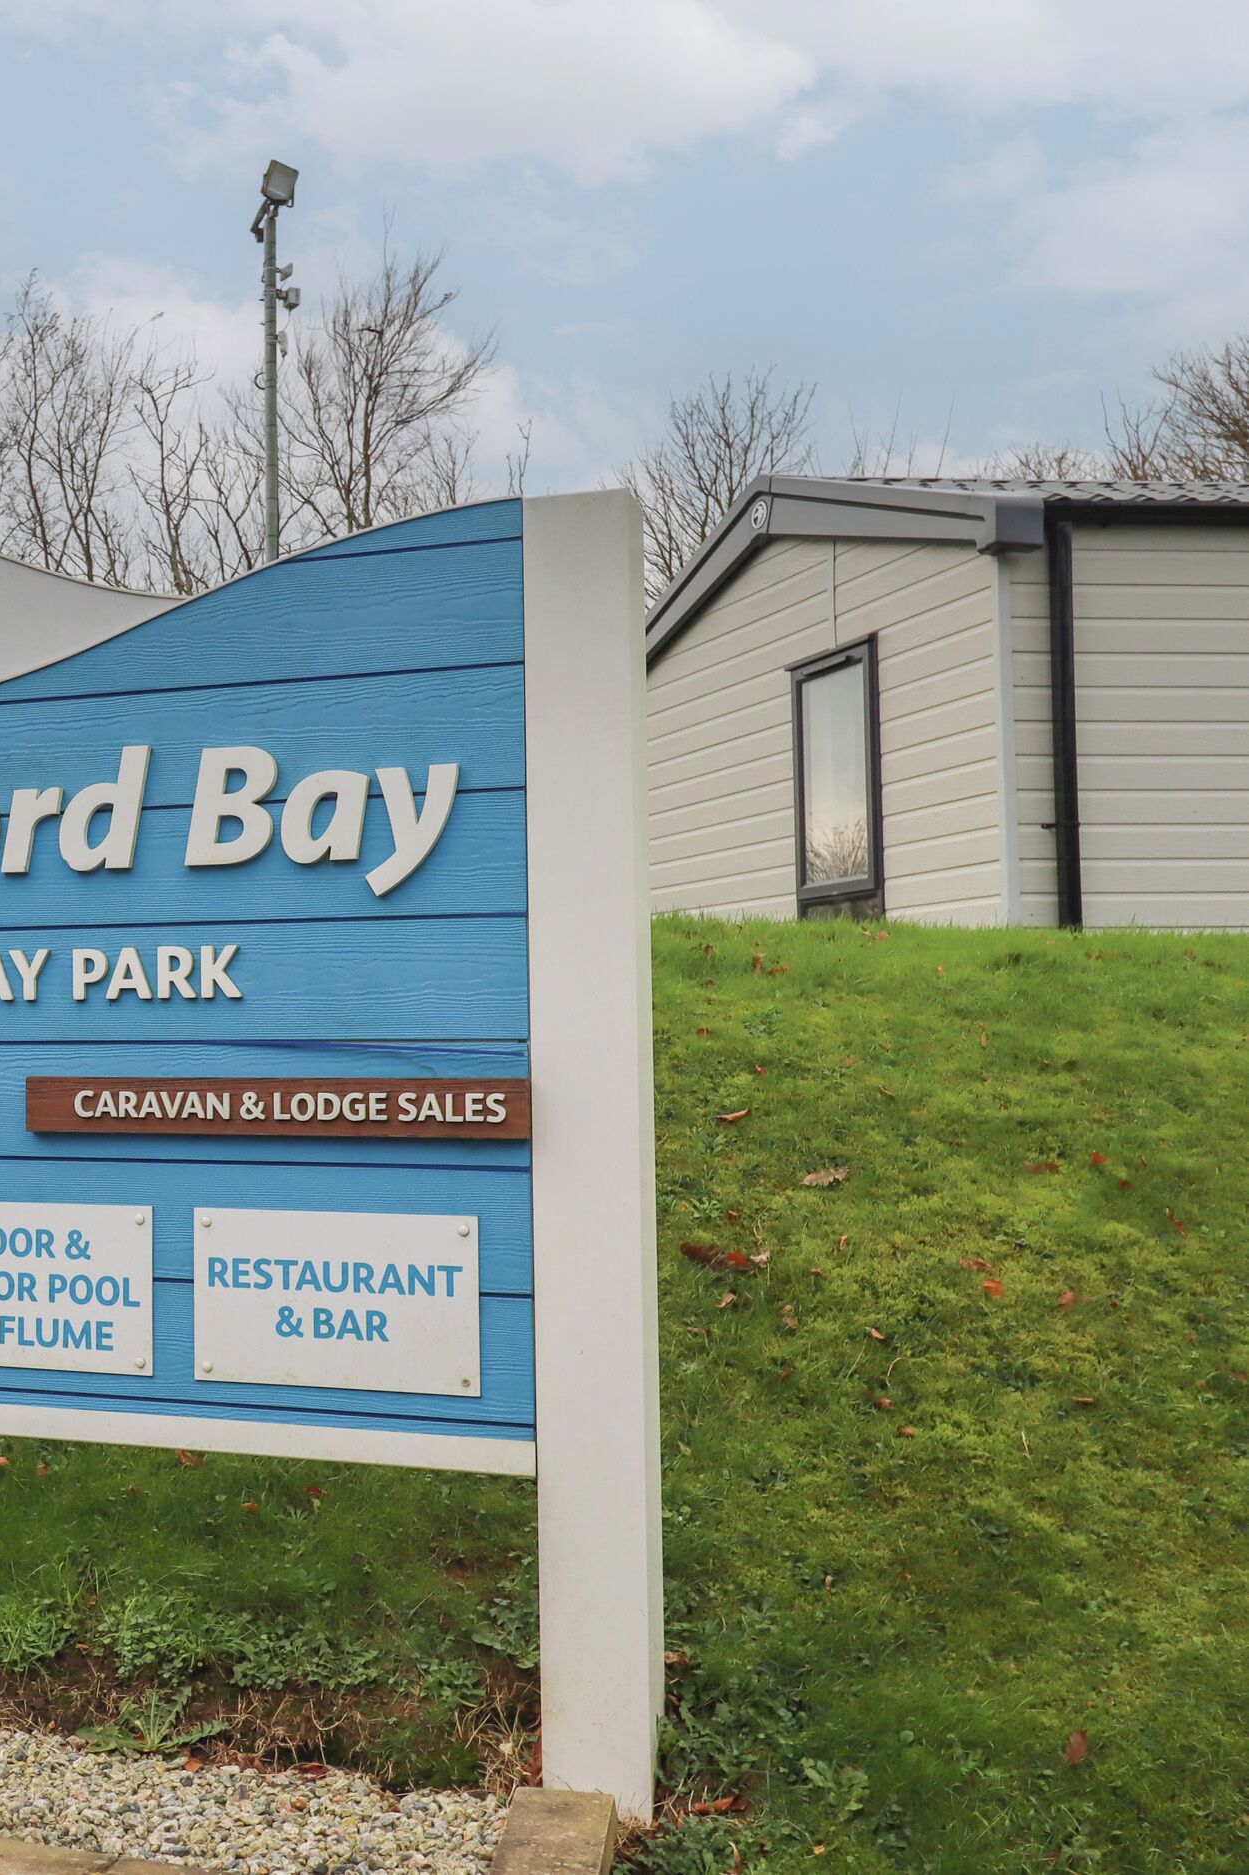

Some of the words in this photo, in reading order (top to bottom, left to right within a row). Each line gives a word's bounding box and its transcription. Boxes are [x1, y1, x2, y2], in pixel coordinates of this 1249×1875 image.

[184, 746, 460, 897] Bay
[72, 944, 242, 1001] PARK
[74, 1090, 231, 1120] CARAVAN
[239, 1091, 265, 1122] &
[273, 1091, 388, 1123] LODGE
[397, 1092, 507, 1124] SALES
[64, 1229, 91, 1260] &
[48, 1273, 141, 1308] POOL
[208, 1256, 464, 1297] RESTAURANT
[275, 1305, 304, 1338] &
[313, 1307, 389, 1342] BAR
